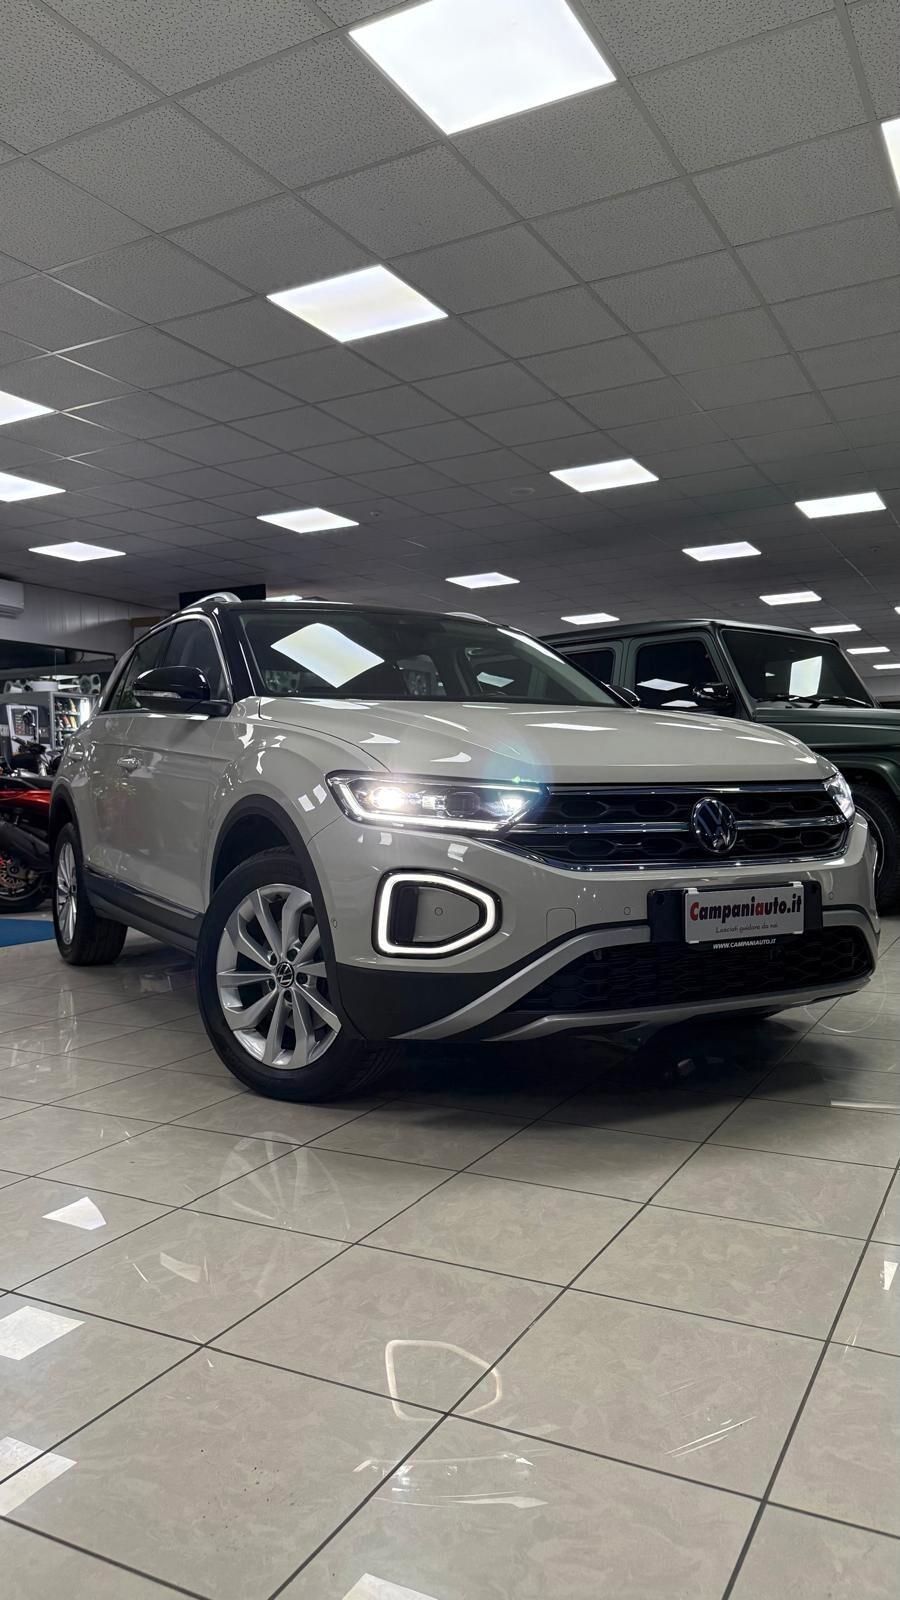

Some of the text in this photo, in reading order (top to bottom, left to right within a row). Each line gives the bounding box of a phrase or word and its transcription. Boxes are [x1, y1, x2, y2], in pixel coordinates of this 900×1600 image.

[690, 893, 802, 923] Campaniauto.it
[739, 922, 760, 933] guidare
[713, 938, 777, 949] WWW.CAMPANIAUTO.IT
